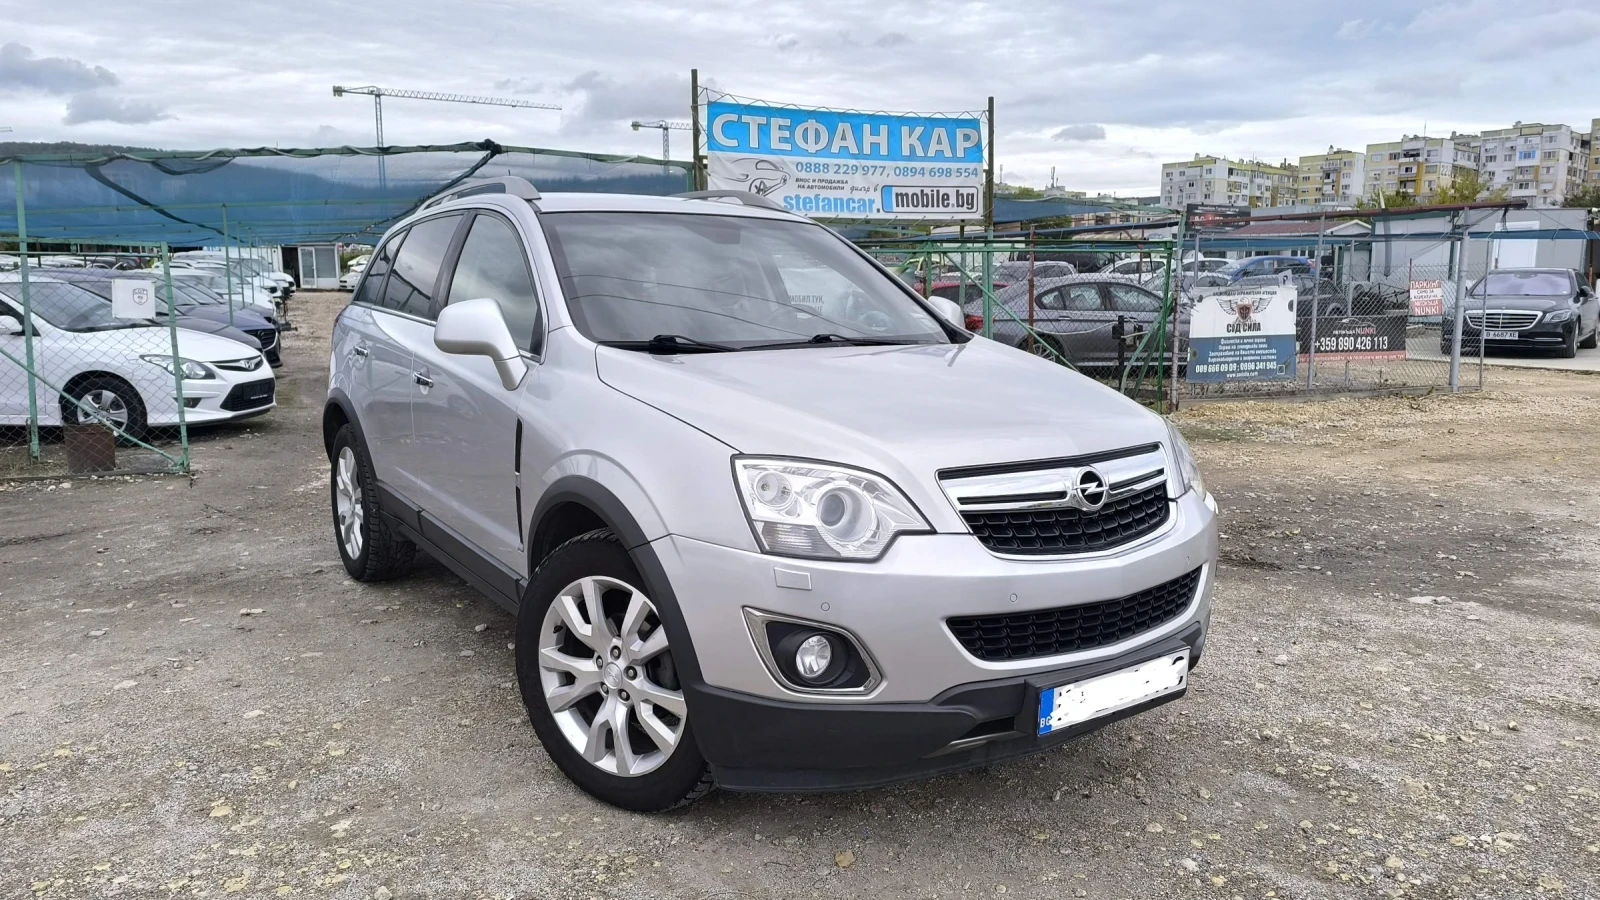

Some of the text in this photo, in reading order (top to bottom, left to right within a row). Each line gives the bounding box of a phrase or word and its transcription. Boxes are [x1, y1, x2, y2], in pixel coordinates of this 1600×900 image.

[712, 113, 979, 158] СТЕФАН КАР
[795, 162, 979, 178] 0888 229 977, 0894 698 554
[895, 189, 975, 210] mobile.bg
[1410, 280, 1439, 289] ПАРКИНГ
[1415, 306, 1438, 315] NUNKI
[1242, 322, 1261, 332] СИЛА
[1315, 336, 1388, 350] +359 890 426 113
[1266, 361, 1277, 369] 945
